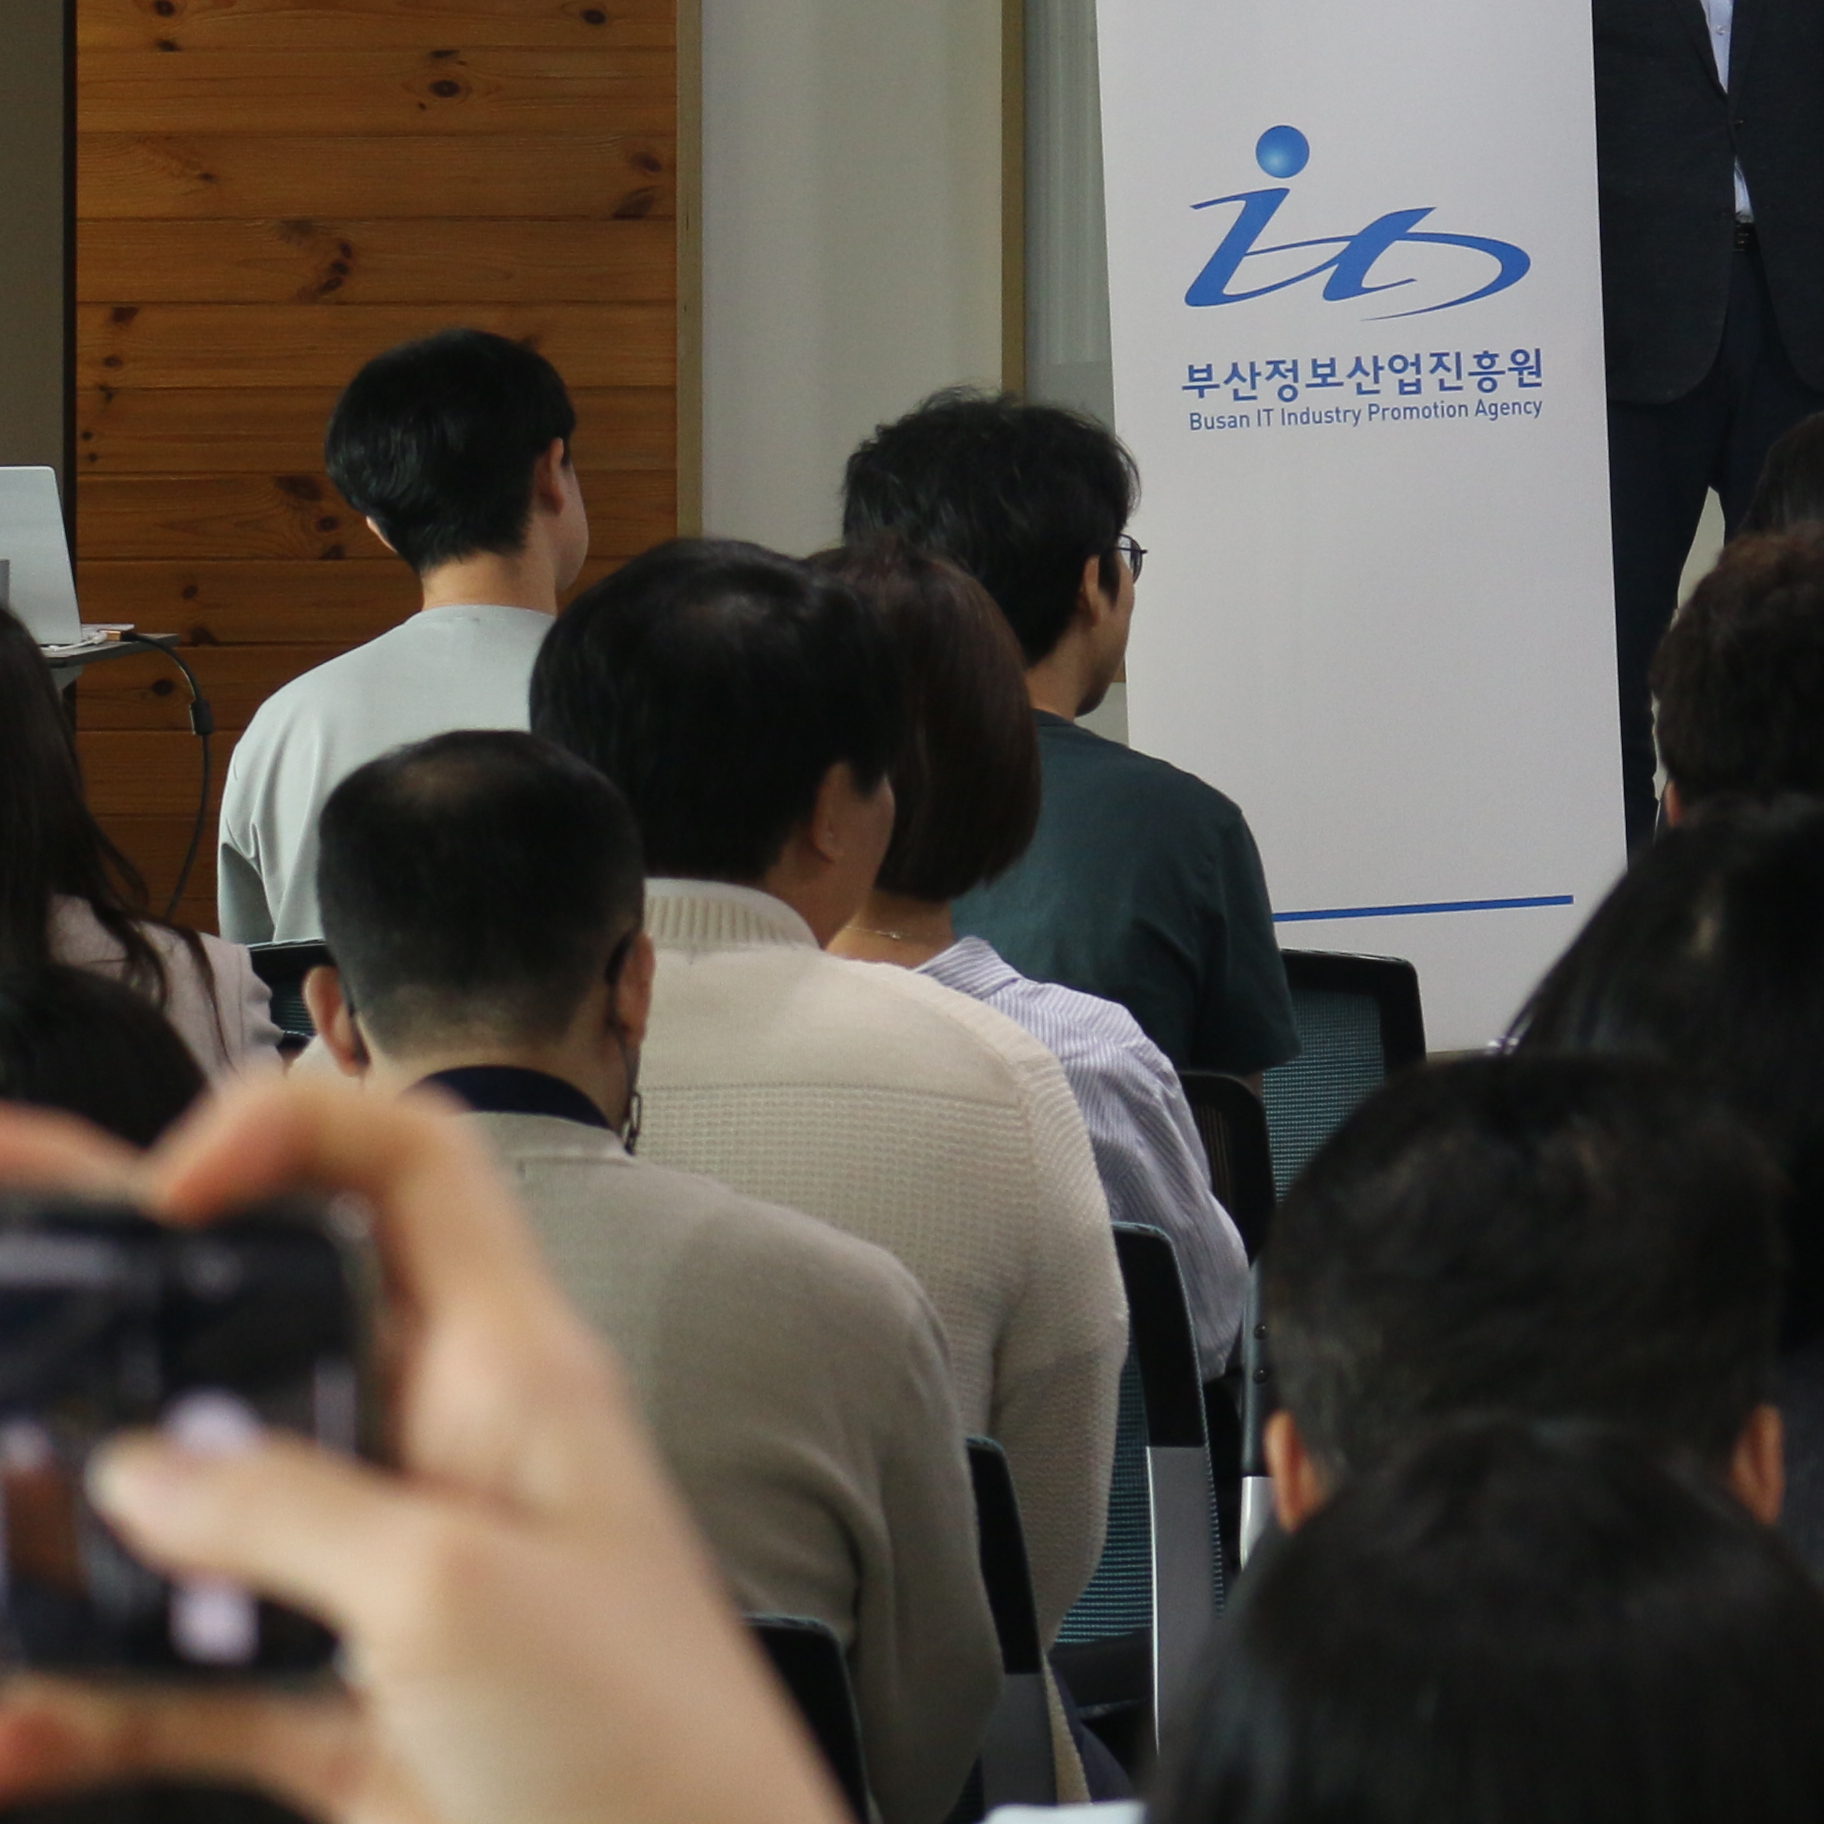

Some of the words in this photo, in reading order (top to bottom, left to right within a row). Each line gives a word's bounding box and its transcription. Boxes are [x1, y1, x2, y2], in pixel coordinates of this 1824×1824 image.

[1182, 348, 1542, 402] 부산정보산업진흥원
[1189, 412, 1249, 430] Busan
[1257, 409, 1273, 426] IT
[1281, 407, 1361, 426] Industry
[1368, 400, 1468, 421] Promotion
[1475, 399, 1542, 421] Agency
